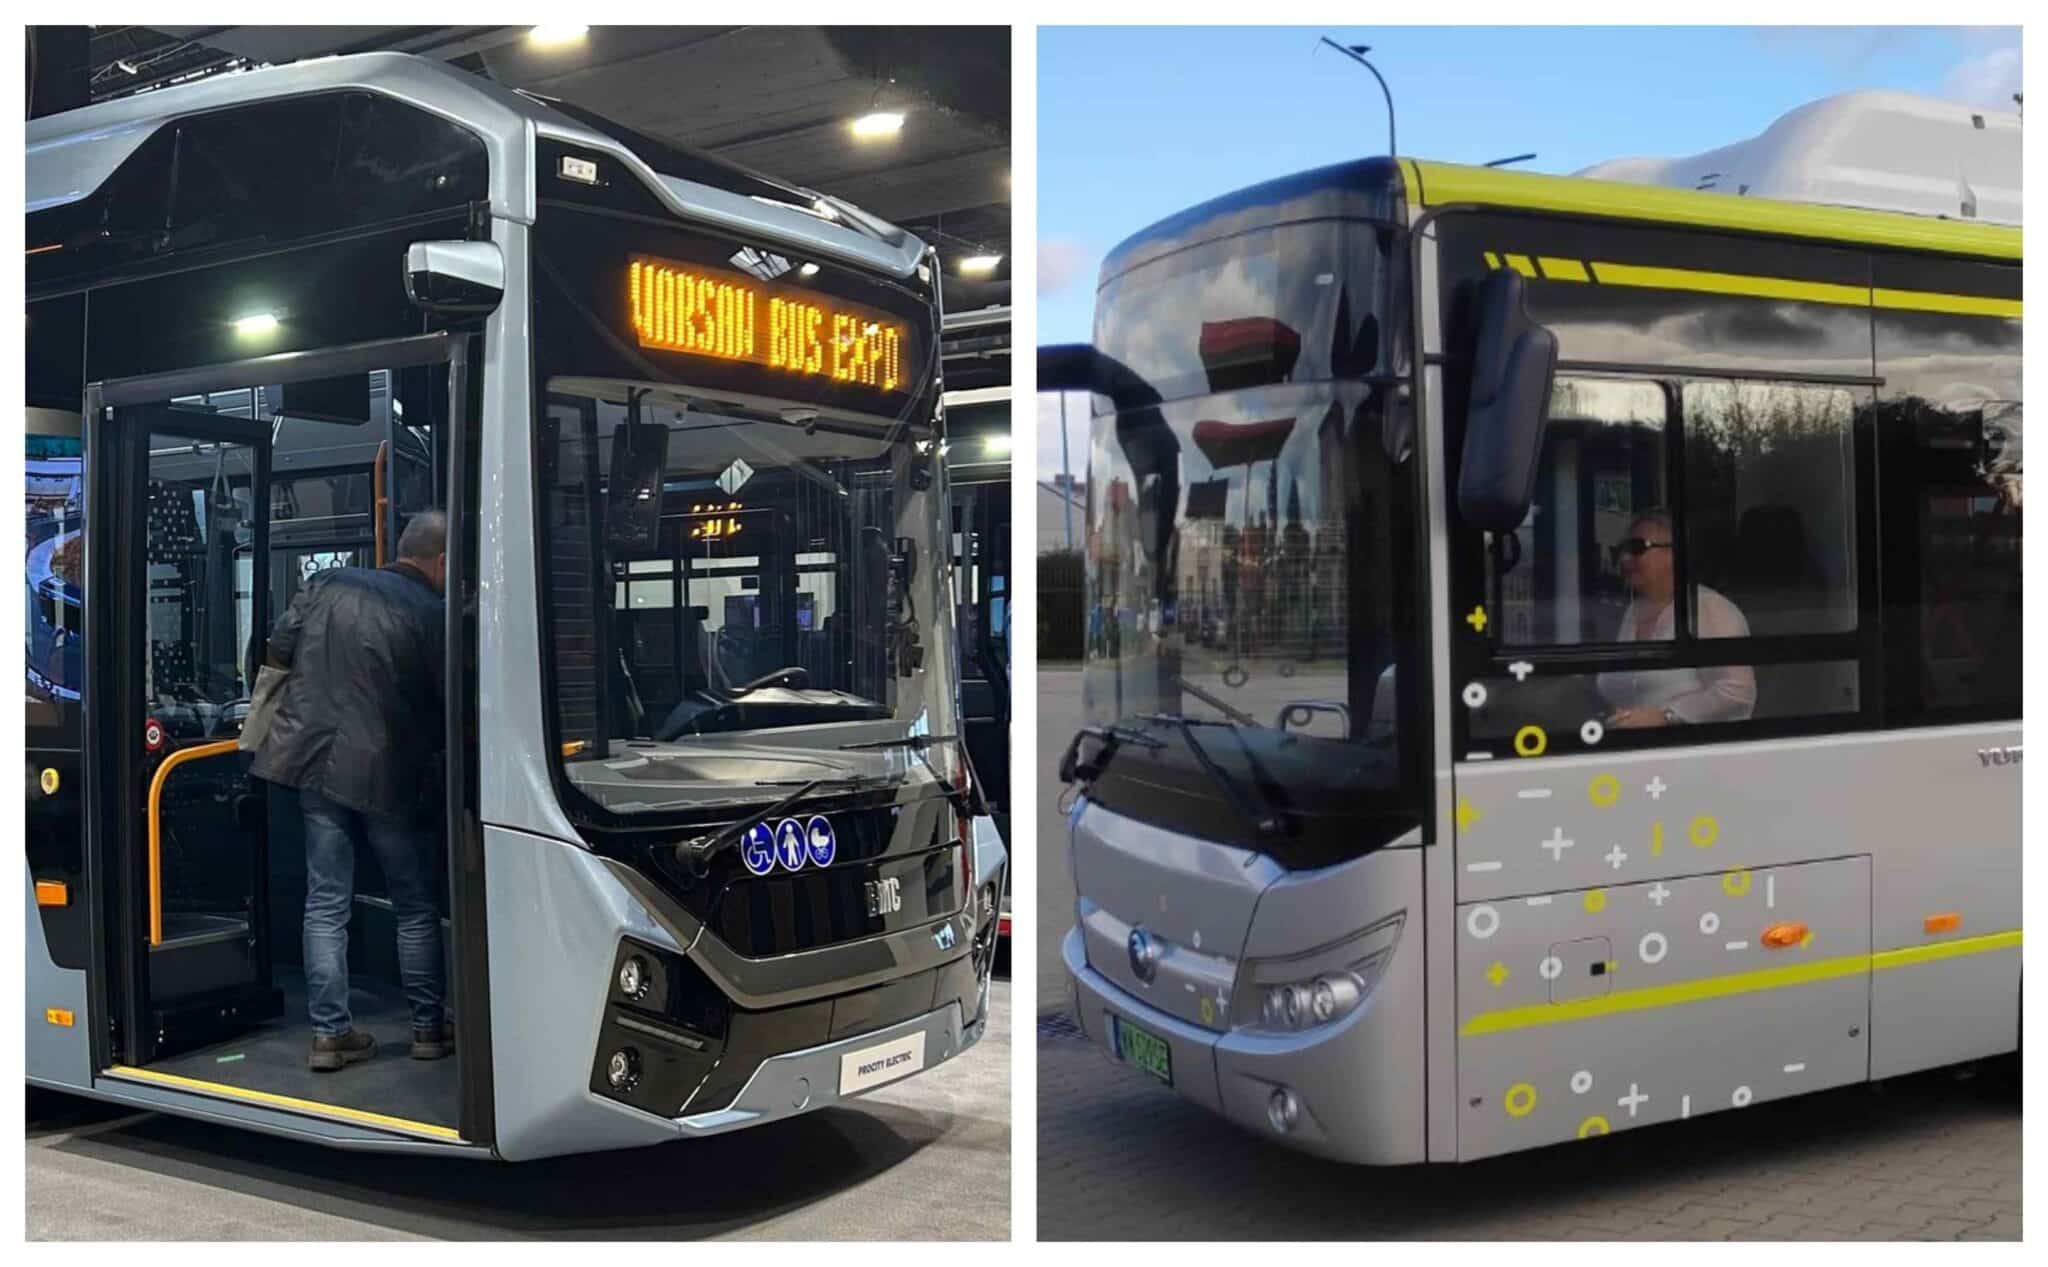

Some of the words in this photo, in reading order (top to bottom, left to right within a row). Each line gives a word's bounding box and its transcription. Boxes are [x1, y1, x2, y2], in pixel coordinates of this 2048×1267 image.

[630, 262, 754, 357] WARSAW
[769, 297, 823, 374] BUS
[832, 313, 898, 390] EXPO
[1977, 746, 2022, 768] YUT
